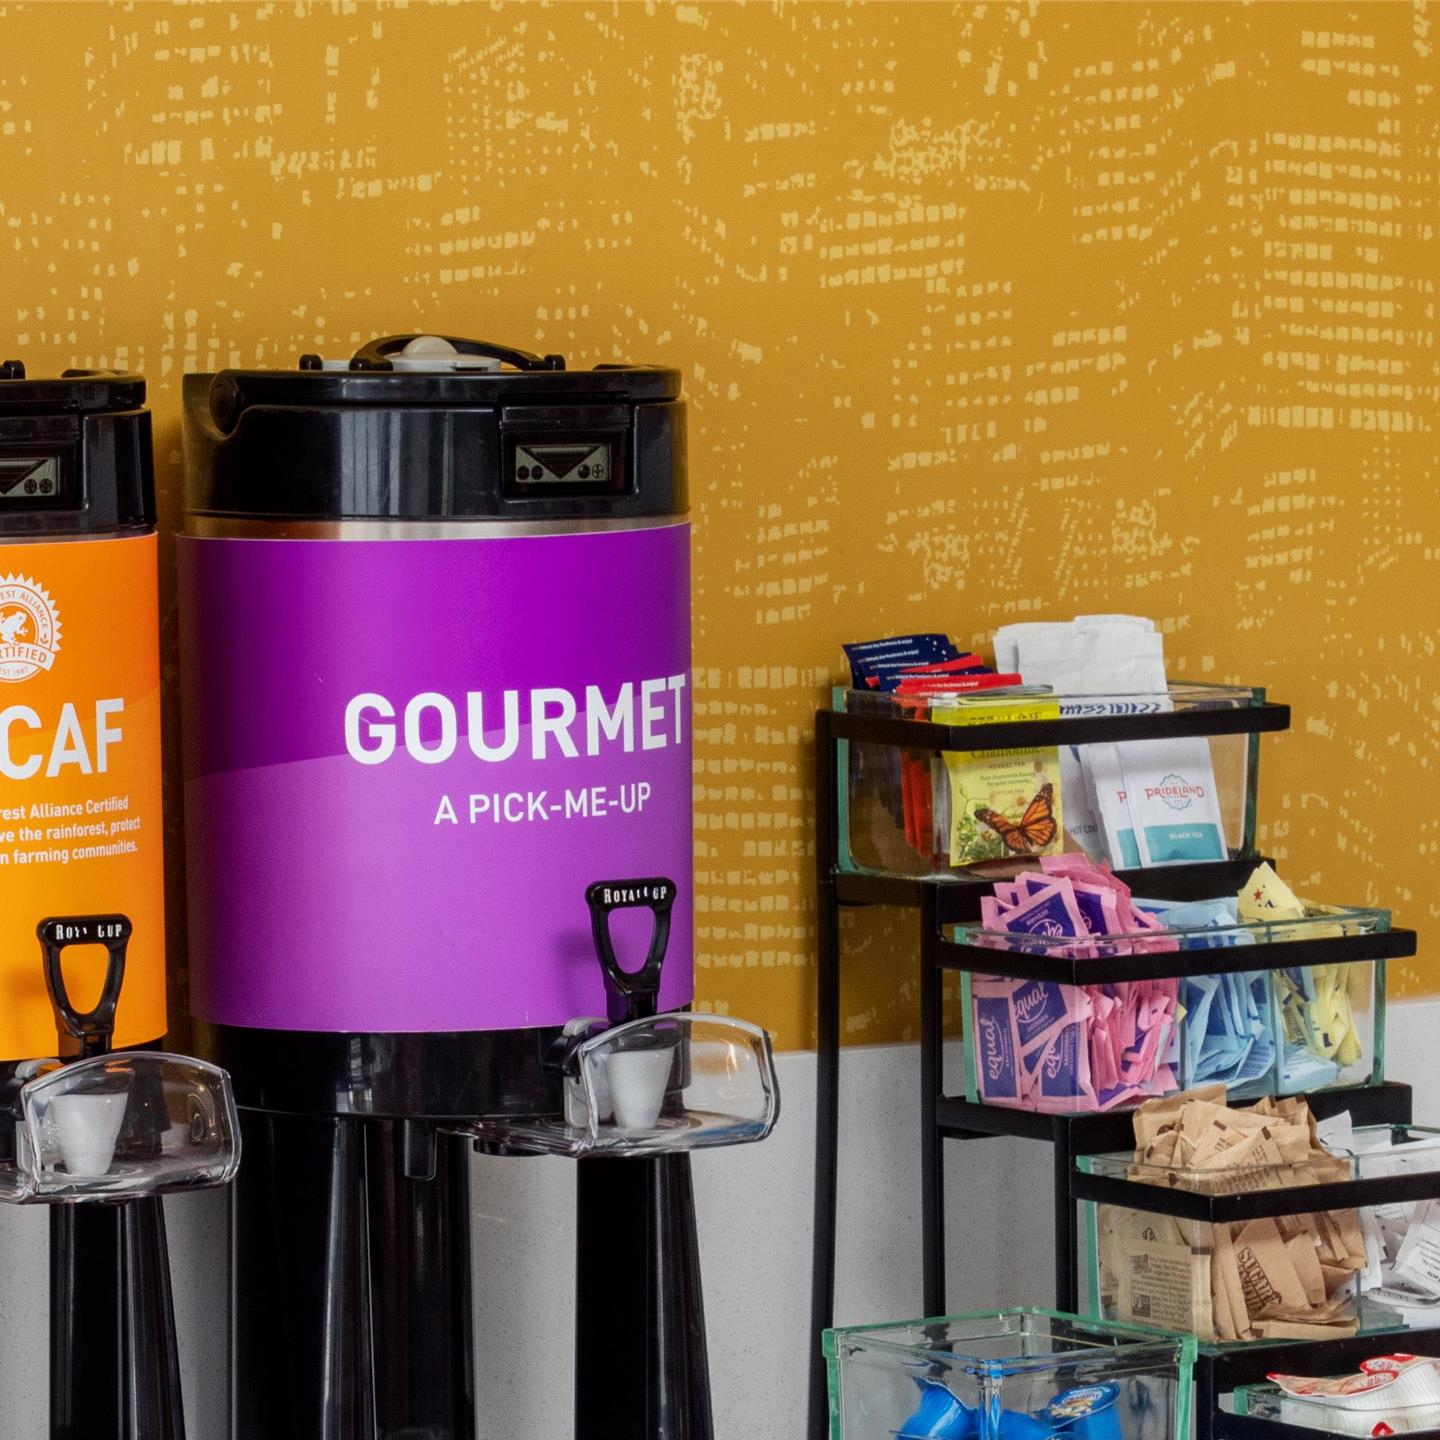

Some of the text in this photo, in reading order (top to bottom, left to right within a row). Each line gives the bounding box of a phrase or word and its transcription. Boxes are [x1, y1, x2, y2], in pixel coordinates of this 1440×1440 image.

[19, 591, 49, 629] ALLIANCE
[344, 674, 686, 766] GOURMET
[29, 802, 83, 819] Alliance
[86, 795, 128, 814] Certified
[433, 782, 651, 826] A PICK-ME-UP
[1144, 785, 1205, 800] PRIDELAND
[19, 826, 42, 841] the
[46, 820, 109, 841] rainforest,
[110, 815, 141, 837] protect
[14, 846, 69, 865] farming
[72, 839, 138, 860] communities.
[1015, 981, 1049, 1019] qual
[980, 1015, 1003, 1080] equal
[1237, 1246, 1277, 1305] SUGAR
